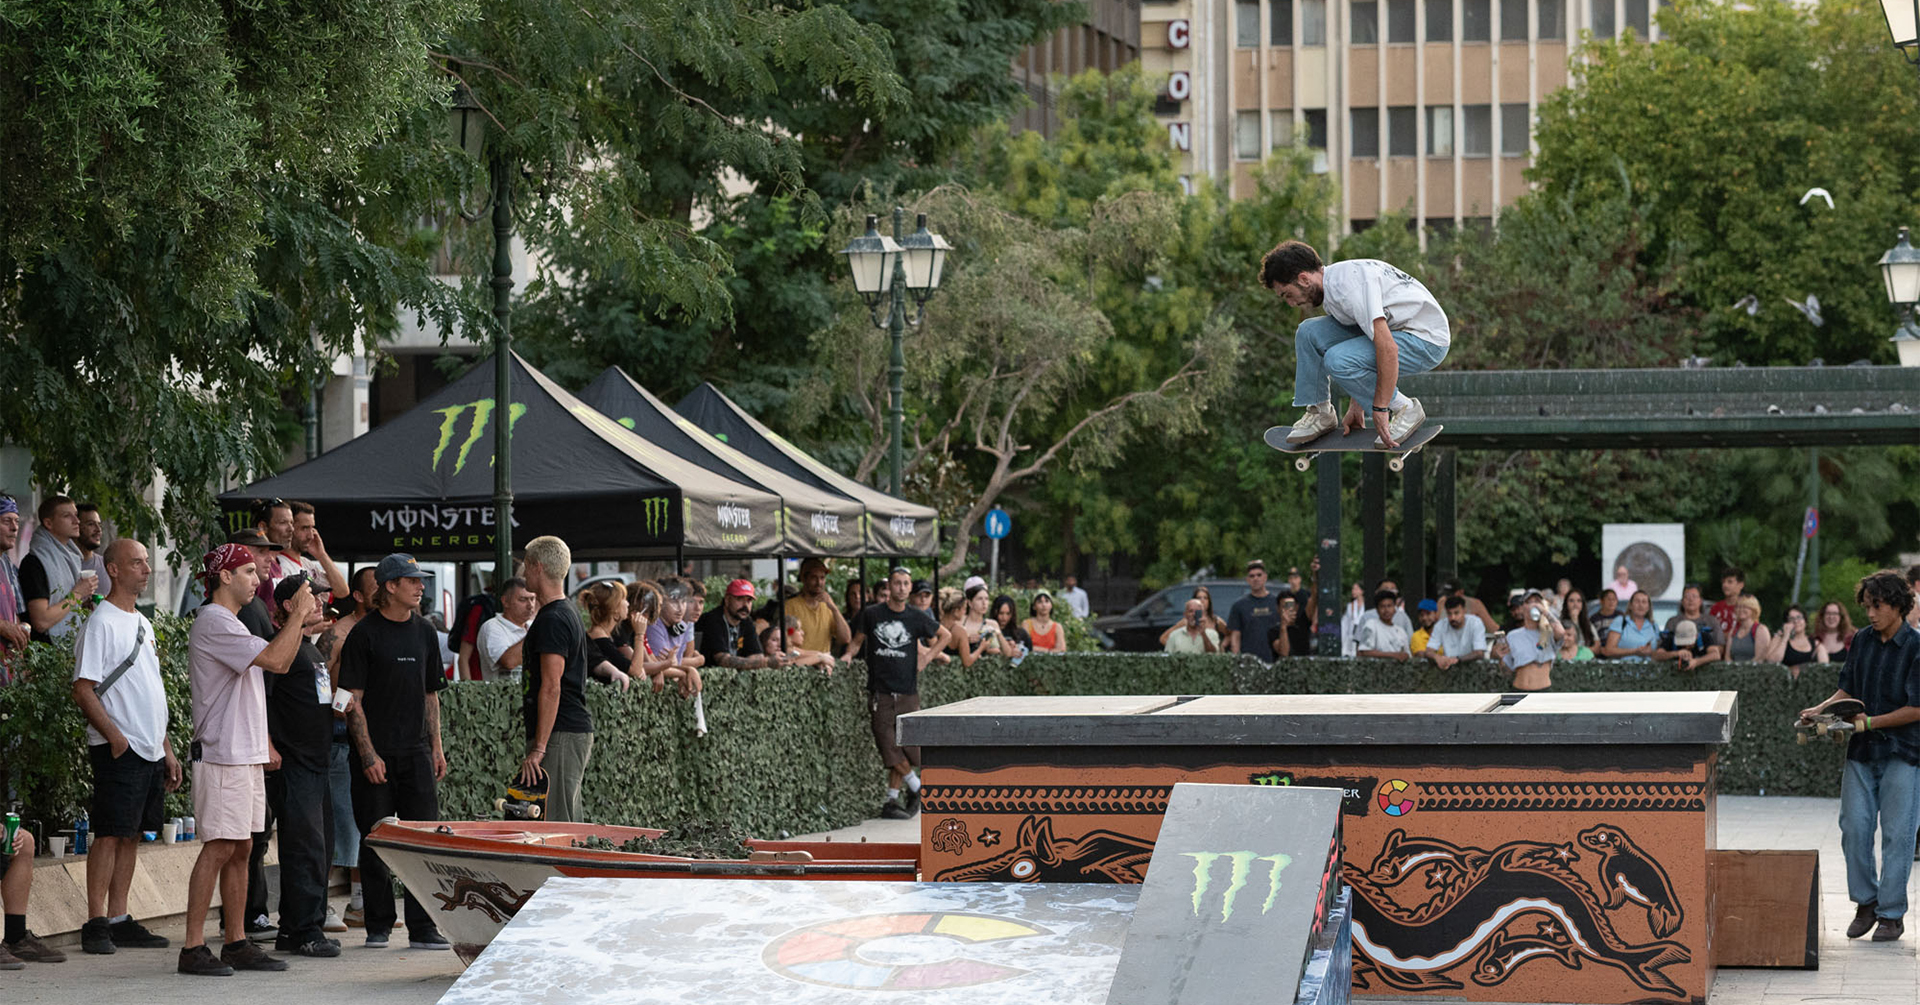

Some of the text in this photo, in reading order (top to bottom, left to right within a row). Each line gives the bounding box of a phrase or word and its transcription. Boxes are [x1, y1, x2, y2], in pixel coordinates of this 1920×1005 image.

[717, 502, 751, 529] MONSTER
[810, 511, 840, 535] MONSTER
[393, 534, 496, 547] ENERGY
